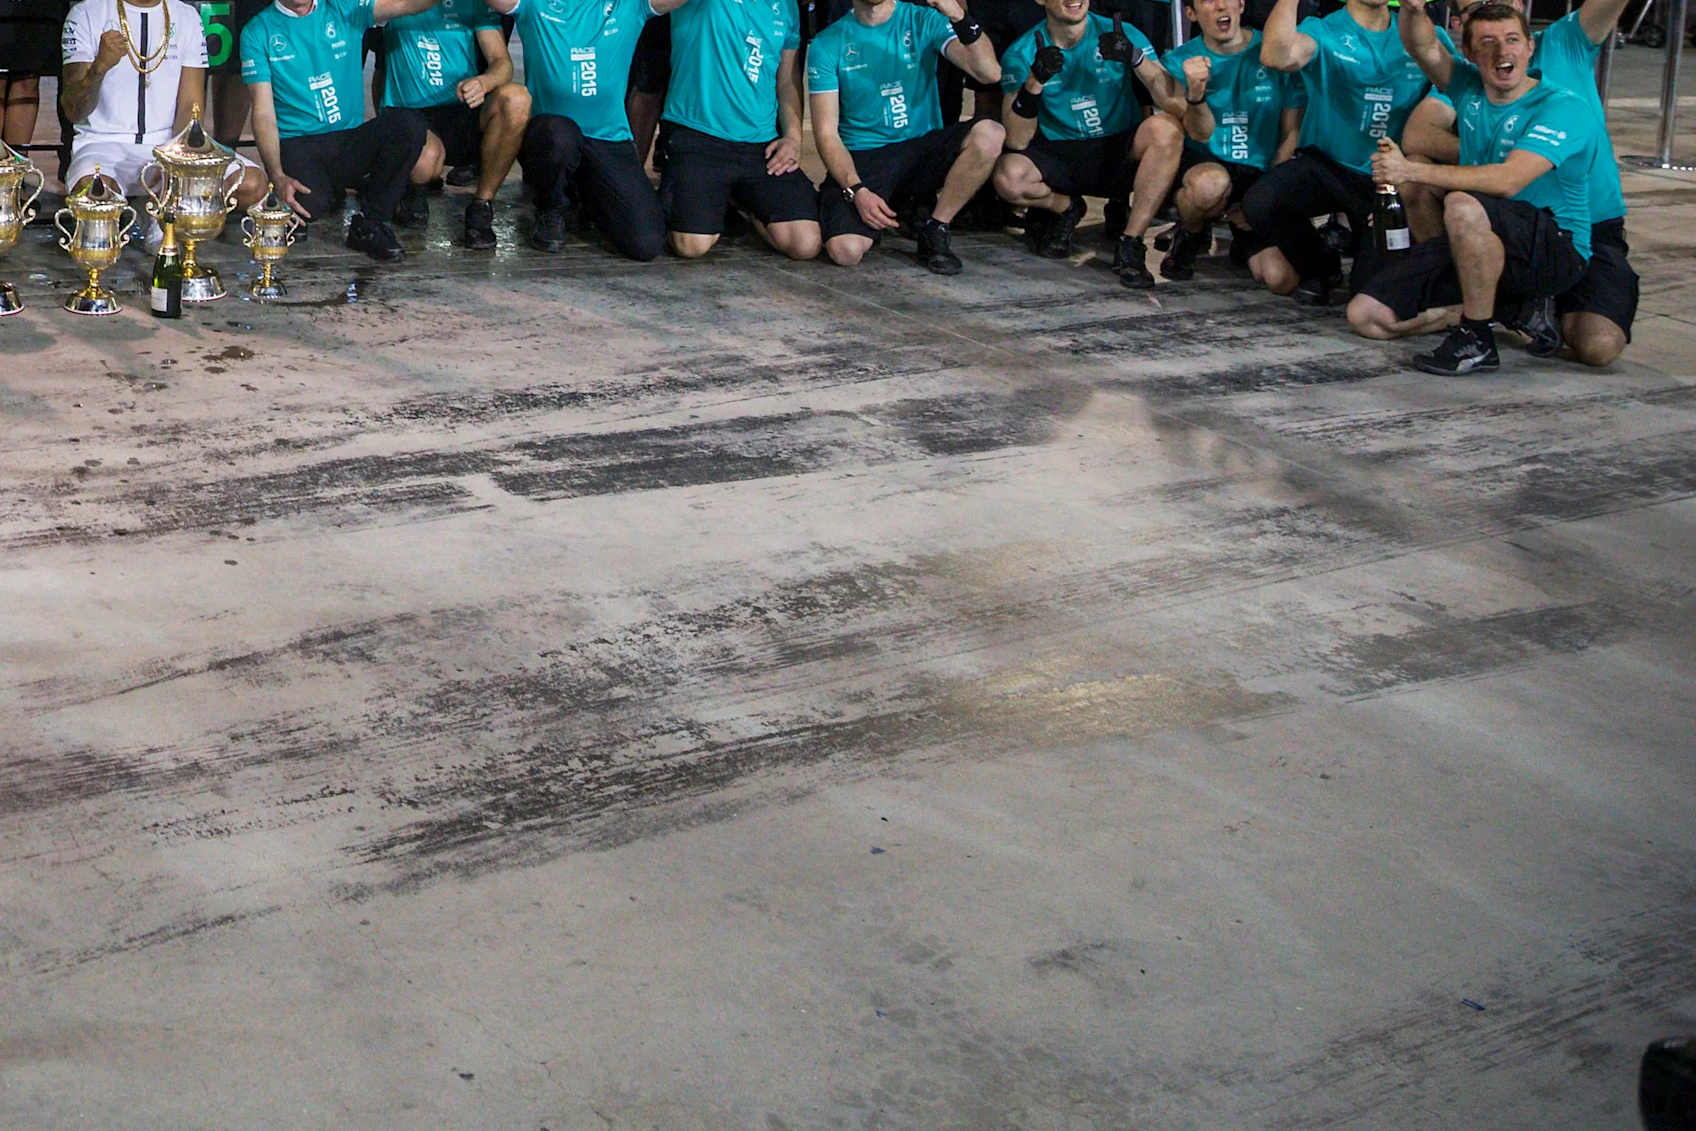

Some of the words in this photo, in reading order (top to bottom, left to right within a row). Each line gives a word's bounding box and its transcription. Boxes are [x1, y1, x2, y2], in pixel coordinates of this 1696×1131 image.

[570, 46, 595, 54] RACE
[308, 72, 332, 83] RACE
[426, 51, 444, 87] 2015
[580, 61, 597, 97] 2015
[320, 86, 342, 125] 2015
[1365, 87, 1394, 95] RACE
[889, 94, 909, 129] 2015
[1083, 108, 1104, 136] 201
[1369, 102, 1392, 138] 2015
[1232, 126, 1249, 160] 2015
